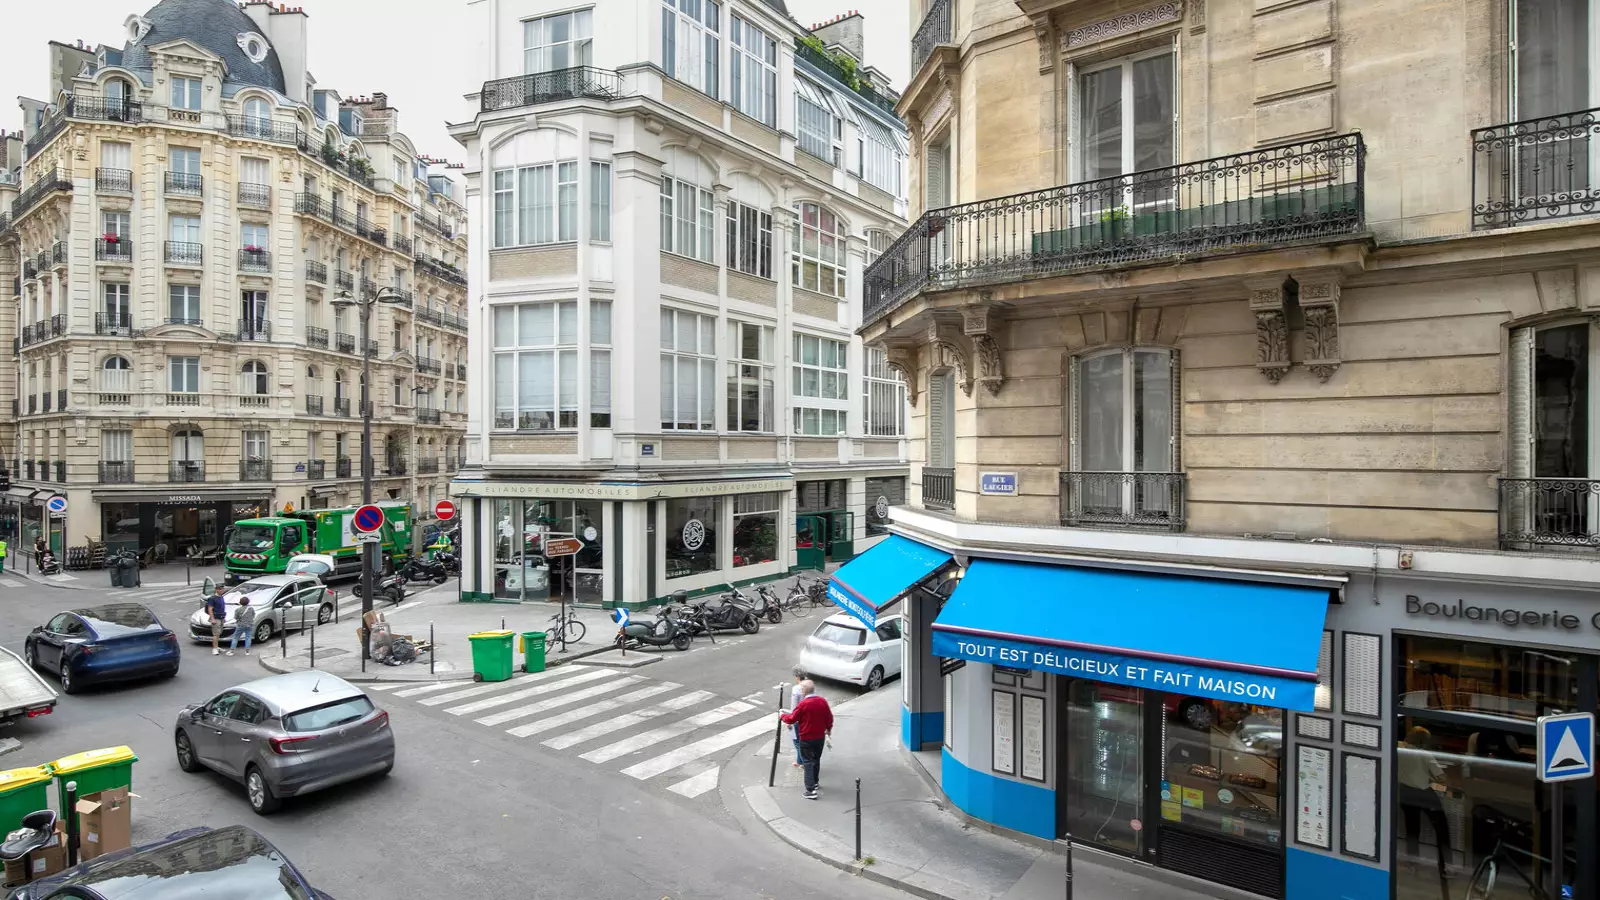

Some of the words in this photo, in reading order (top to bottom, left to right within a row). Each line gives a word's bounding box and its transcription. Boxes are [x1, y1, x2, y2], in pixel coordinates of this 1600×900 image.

[485, 486, 540, 494] ELIANDRE
[545, 487, 630, 496] AUTOMOBILES
[1405, 594, 1581, 630] Boulangerie
[957, 642, 996, 658] TOUT
[1000, 648, 1029, 663] EST
[1033, 652, 1119, 677] DÉLICIEUX
[1126, 666, 1149, 681] ET
[1153, 669, 1193, 687] FAIT
[1198, 676, 1276, 700] MAISON
